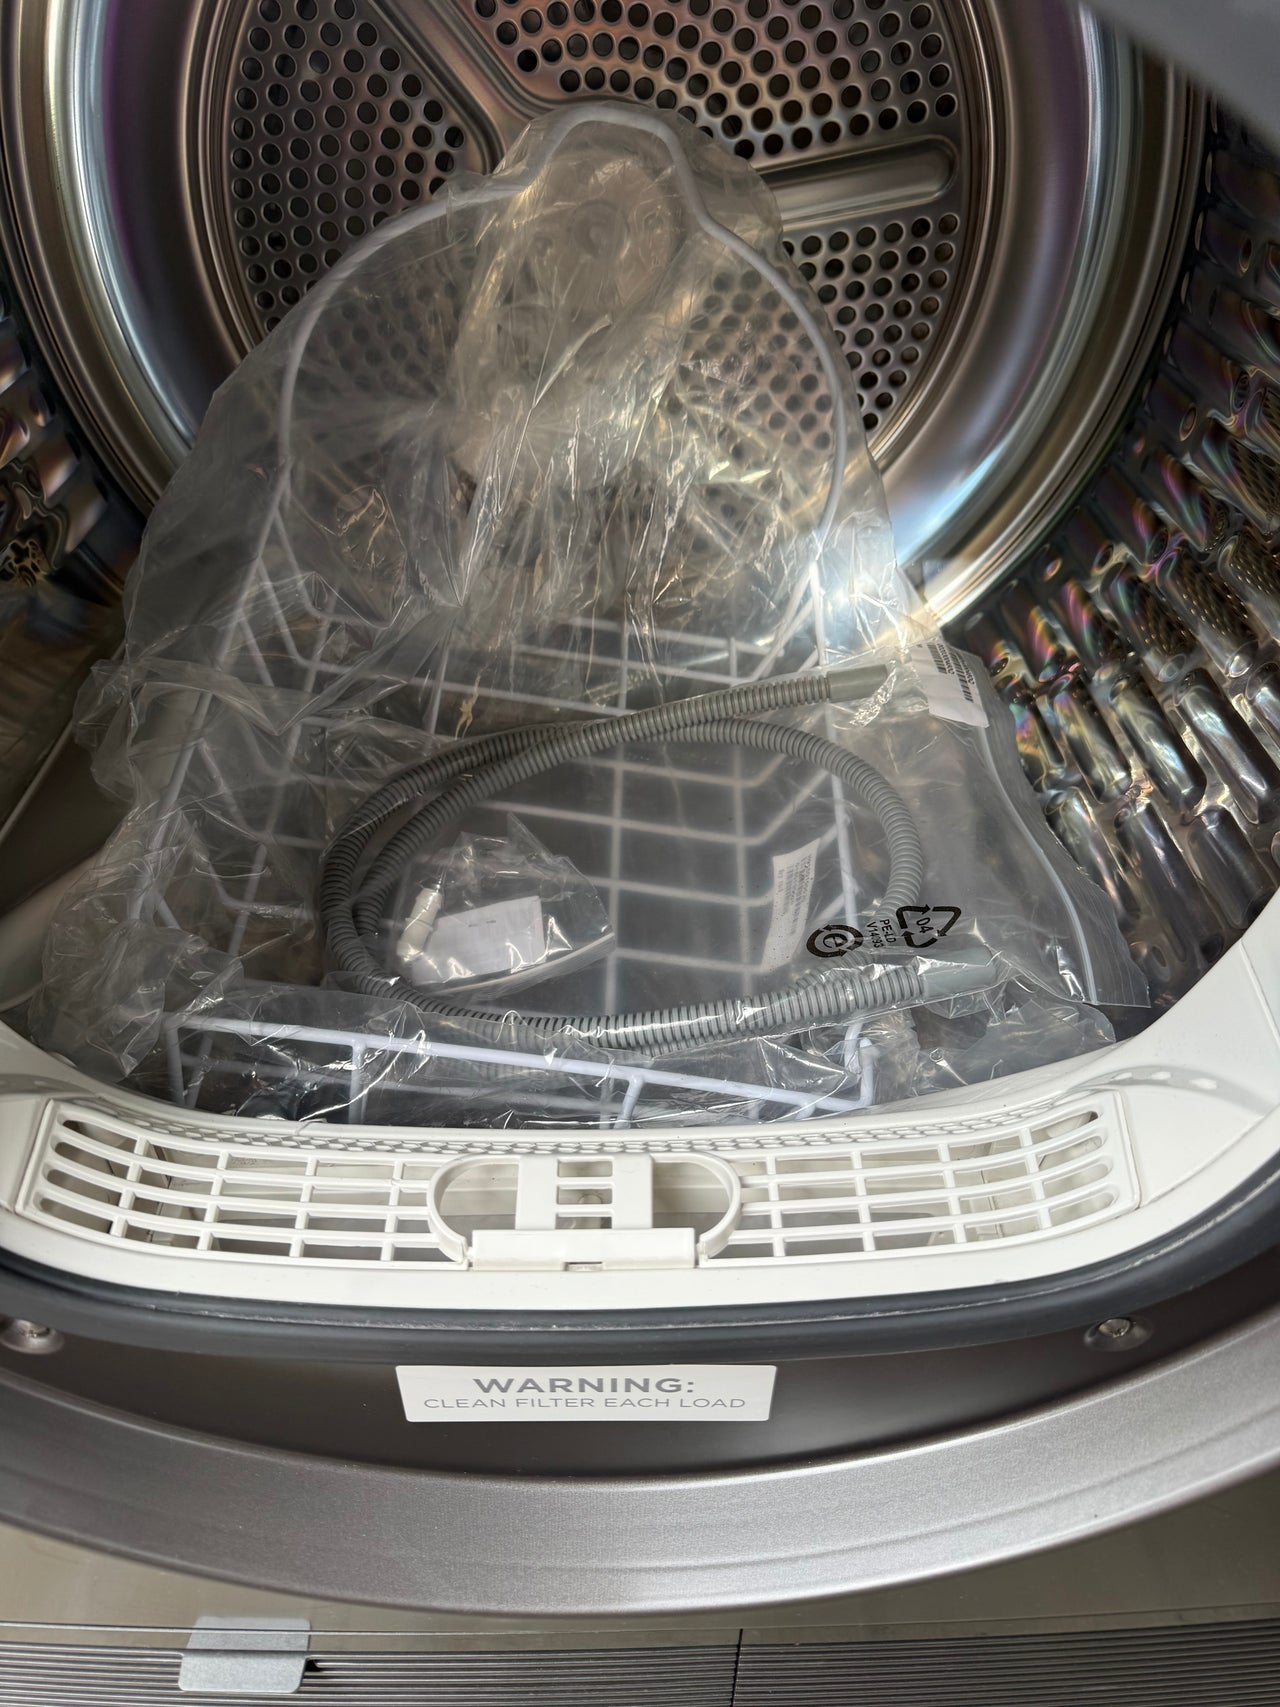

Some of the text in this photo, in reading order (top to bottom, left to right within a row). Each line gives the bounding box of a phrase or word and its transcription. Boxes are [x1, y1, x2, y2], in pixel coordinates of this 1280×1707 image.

[880, 919, 897, 943] PE-LD
[916, 917, 934, 934] 04
[473, 1378, 694, 1393] WARNING:
[424, 1398, 745, 1408] CLEAN FILTER EACH LOAD
